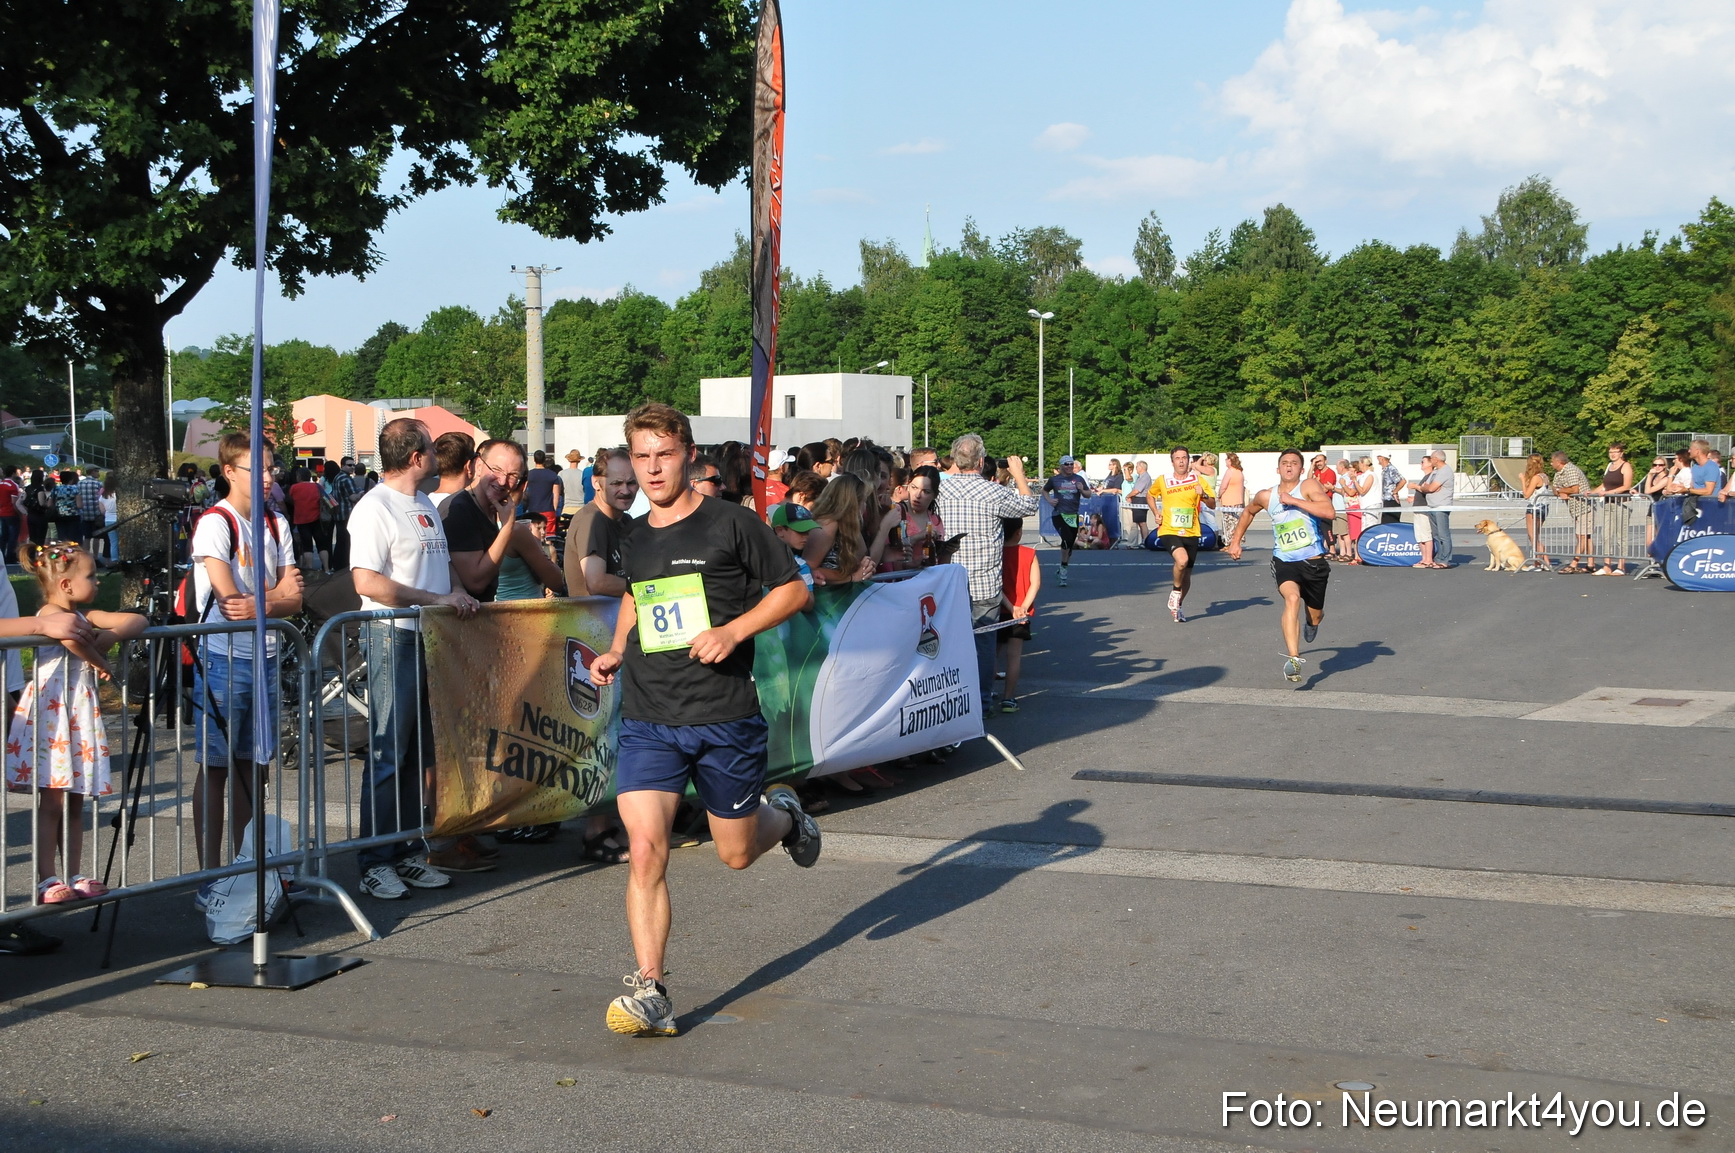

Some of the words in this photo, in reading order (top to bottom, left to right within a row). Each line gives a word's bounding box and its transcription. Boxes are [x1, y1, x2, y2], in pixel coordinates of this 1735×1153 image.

[1175, 515, 1189, 523] 761
[1279, 528, 1307, 545] 1216
[1377, 541, 1420, 552] Fische
[1694, 559, 1735, 572] Fisc
[652, 602, 683, 633] 81
[908, 667, 960, 699] Neumarkter
[575, 696, 592, 713] 1628
[900, 688, 970, 737] Lammsbräu
